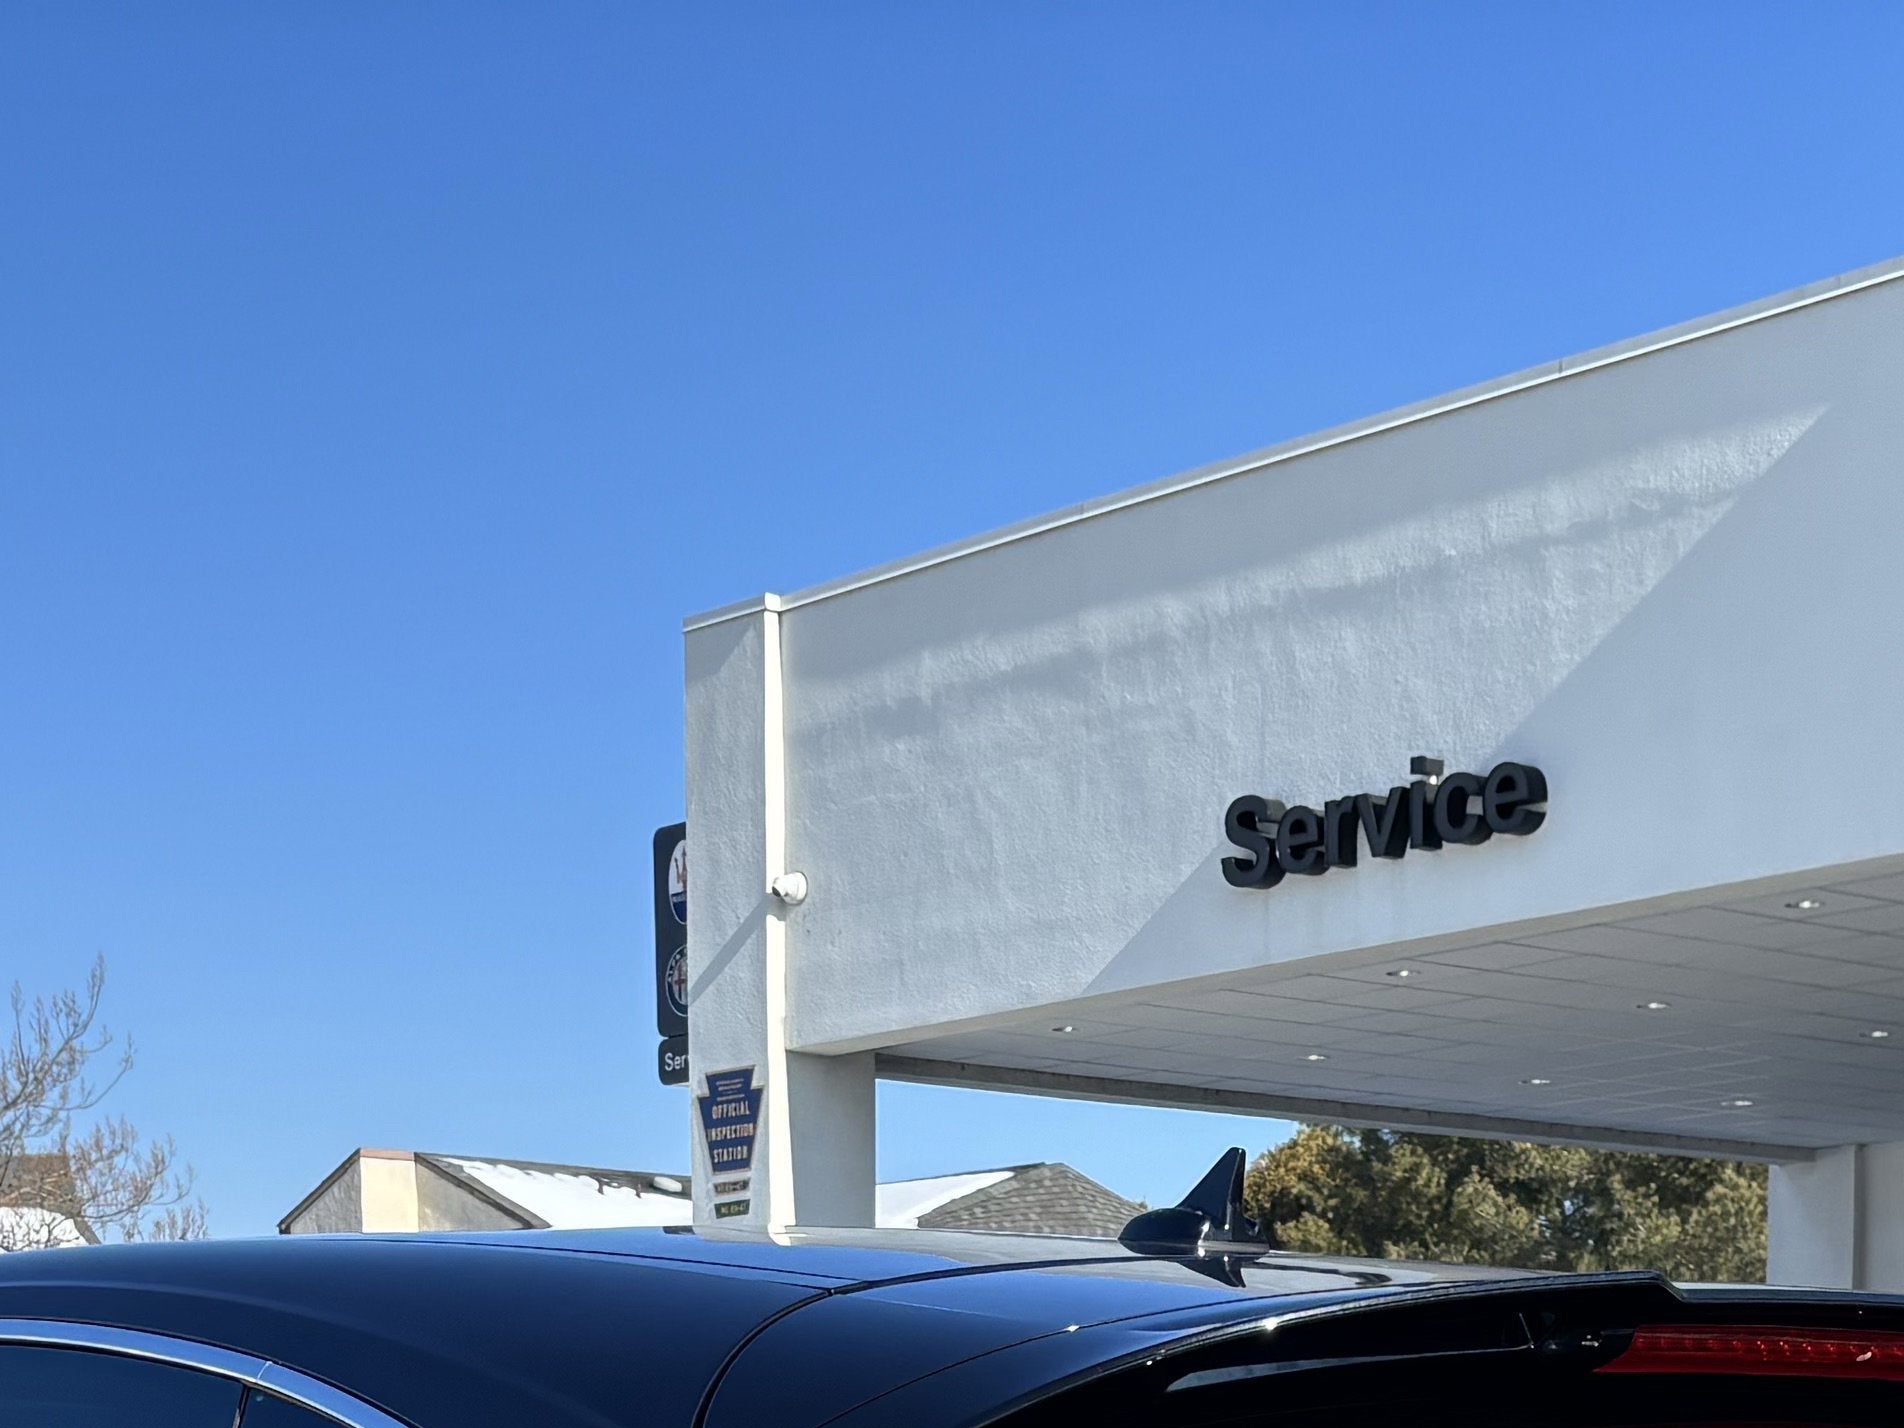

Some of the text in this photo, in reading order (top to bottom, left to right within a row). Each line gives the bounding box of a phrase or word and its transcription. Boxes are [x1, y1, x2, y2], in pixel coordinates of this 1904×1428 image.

[1221, 756, 1548, 889] Service
[712, 1100, 750, 1119] OFFICIAL
[707, 1123, 753, 1141] INSPECTION
[713, 1145, 748, 1163] STATION
